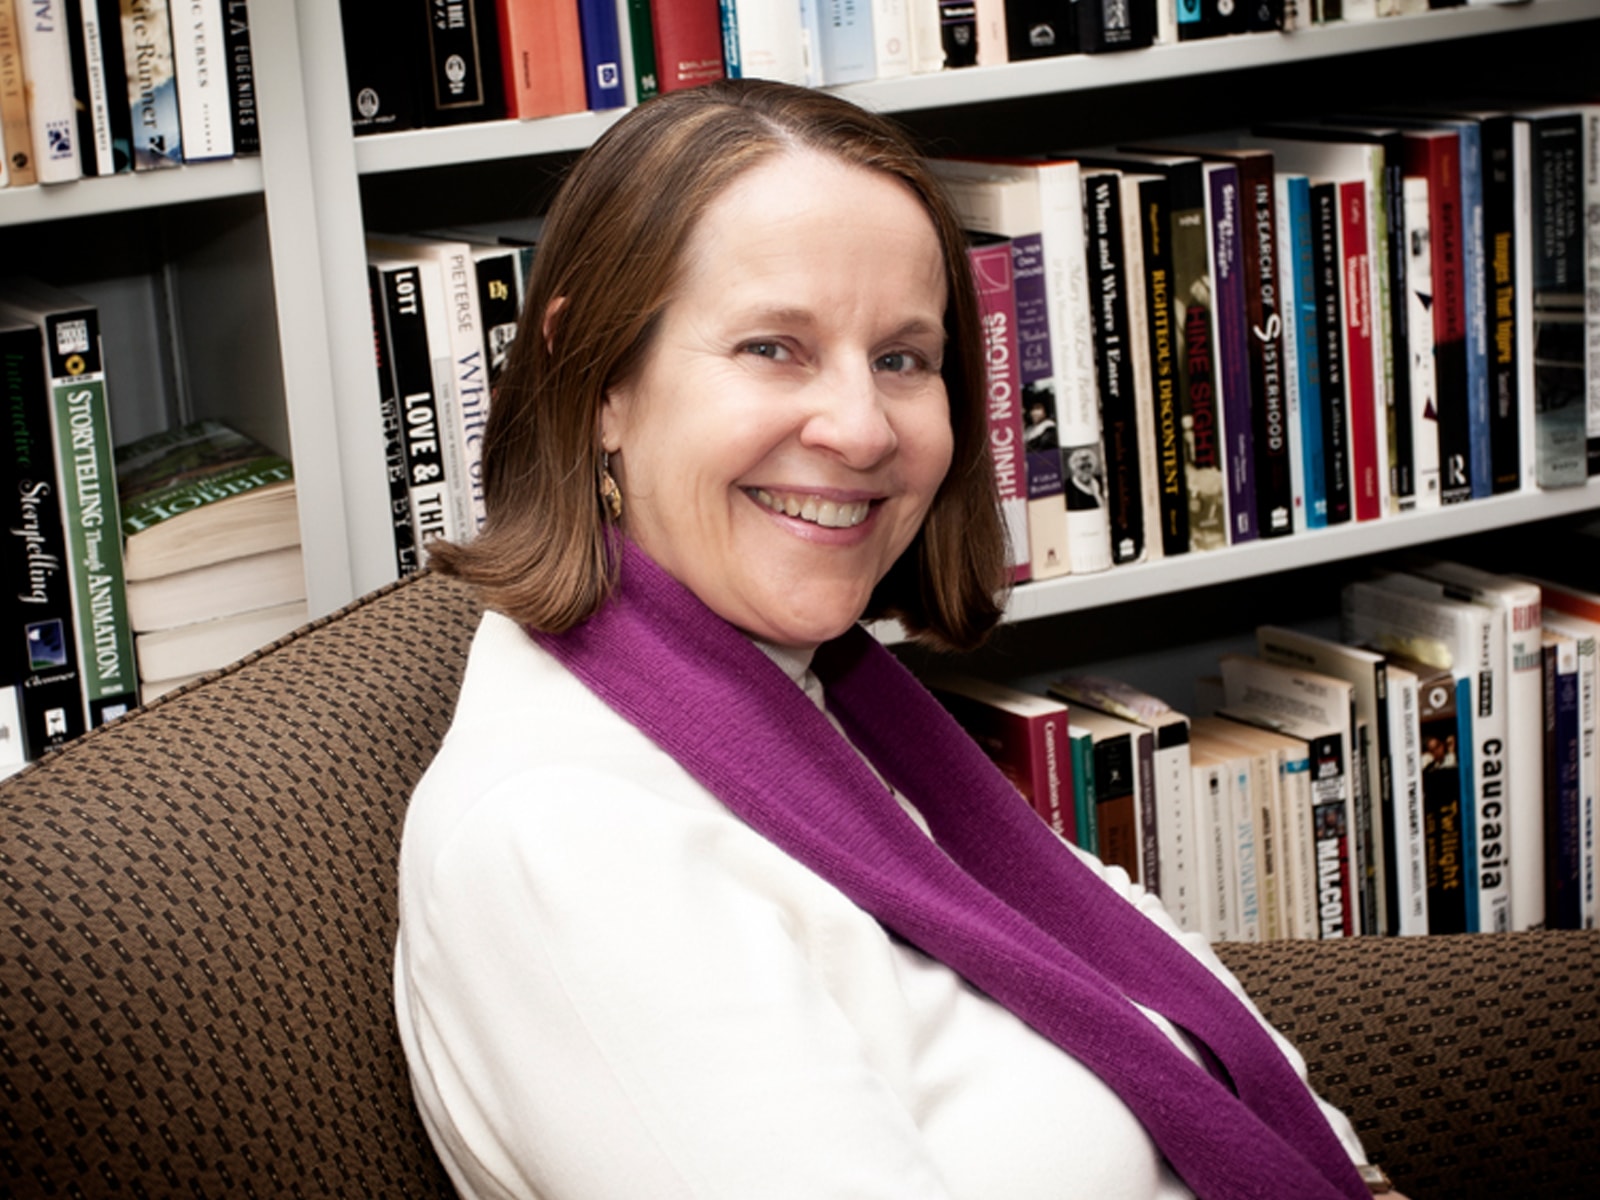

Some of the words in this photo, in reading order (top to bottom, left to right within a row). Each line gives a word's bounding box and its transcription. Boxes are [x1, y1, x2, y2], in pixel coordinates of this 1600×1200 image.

[136, 44, 158, 128] Runner
[194, 22, 208, 88] VERSES
[235, 46, 255, 125] EUGENIDES
[1095, 183, 1110, 234] When
[1222, 184, 1234, 236] Sisters
[1257, 184, 1268, 203] IN
[1100, 238, 1115, 270] and
[1258, 209, 1274, 278] SEARCH
[1443, 203, 1455, 262] OUTLAW
[1493, 232, 1511, 282] Images
[395, 272, 417, 315] LOTT
[451, 254, 472, 333] PIETERSE
[1102, 274, 1117, 331] Where
[1152, 269, 1171, 376] RIGHTEOUS
[1262, 284, 1275, 307] OF
[1445, 270, 1458, 333] CULTURE
[1496, 287, 1513, 317] That
[982, 311, 1012, 420] NOTIONS
[1105, 335, 1119, 343] I
[1187, 306, 1210, 374] HINE
[458, 351, 484, 449] White
[1107, 349, 1121, 397] Enter
[1253, 313, 1282, 450] SISTERHOOD
[4, 354, 32, 468] Interactive
[406, 392, 436, 456] LOVE
[1159, 380, 1178, 495] DISCONTENT
[1191, 381, 1215, 466] SIGHT
[67, 390, 105, 529] STORYTELLING
[381, 398, 405, 483] WHITE
[393, 498, 411, 528] BY
[413, 464, 439, 484] &
[126, 465, 290, 530] HOBBIT
[417, 493, 445, 540] THE
[11, 480, 59, 604] Storytelling
[82, 530, 105, 572] Through
[89, 575, 120, 679] ANIMATION
[1044, 721, 1061, 808] Conversations
[1439, 802, 1459, 889] Twilight
[1481, 739, 1508, 889] caucasia
